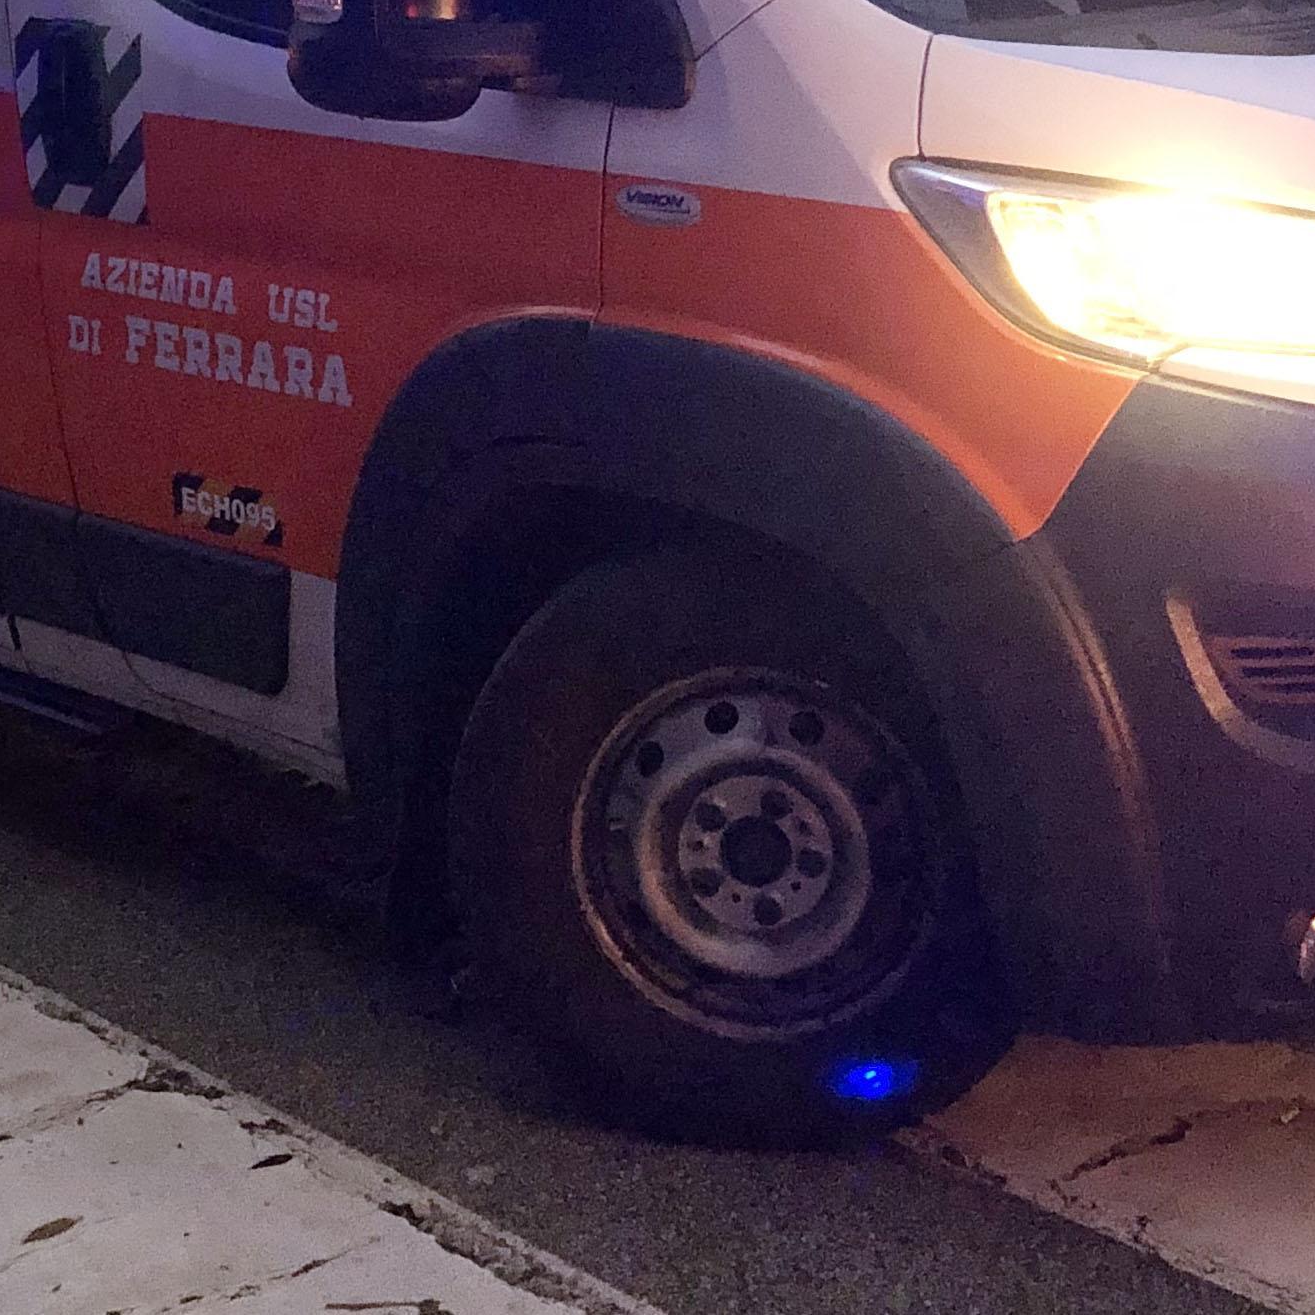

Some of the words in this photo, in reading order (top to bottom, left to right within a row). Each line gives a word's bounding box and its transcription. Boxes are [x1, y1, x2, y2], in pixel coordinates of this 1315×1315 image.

[81, 252, 236, 315] AZIENDA
[268, 284, 338, 333] USL
[68, 315, 102, 356] DI
[125, 315, 353, 407] FERRARA
